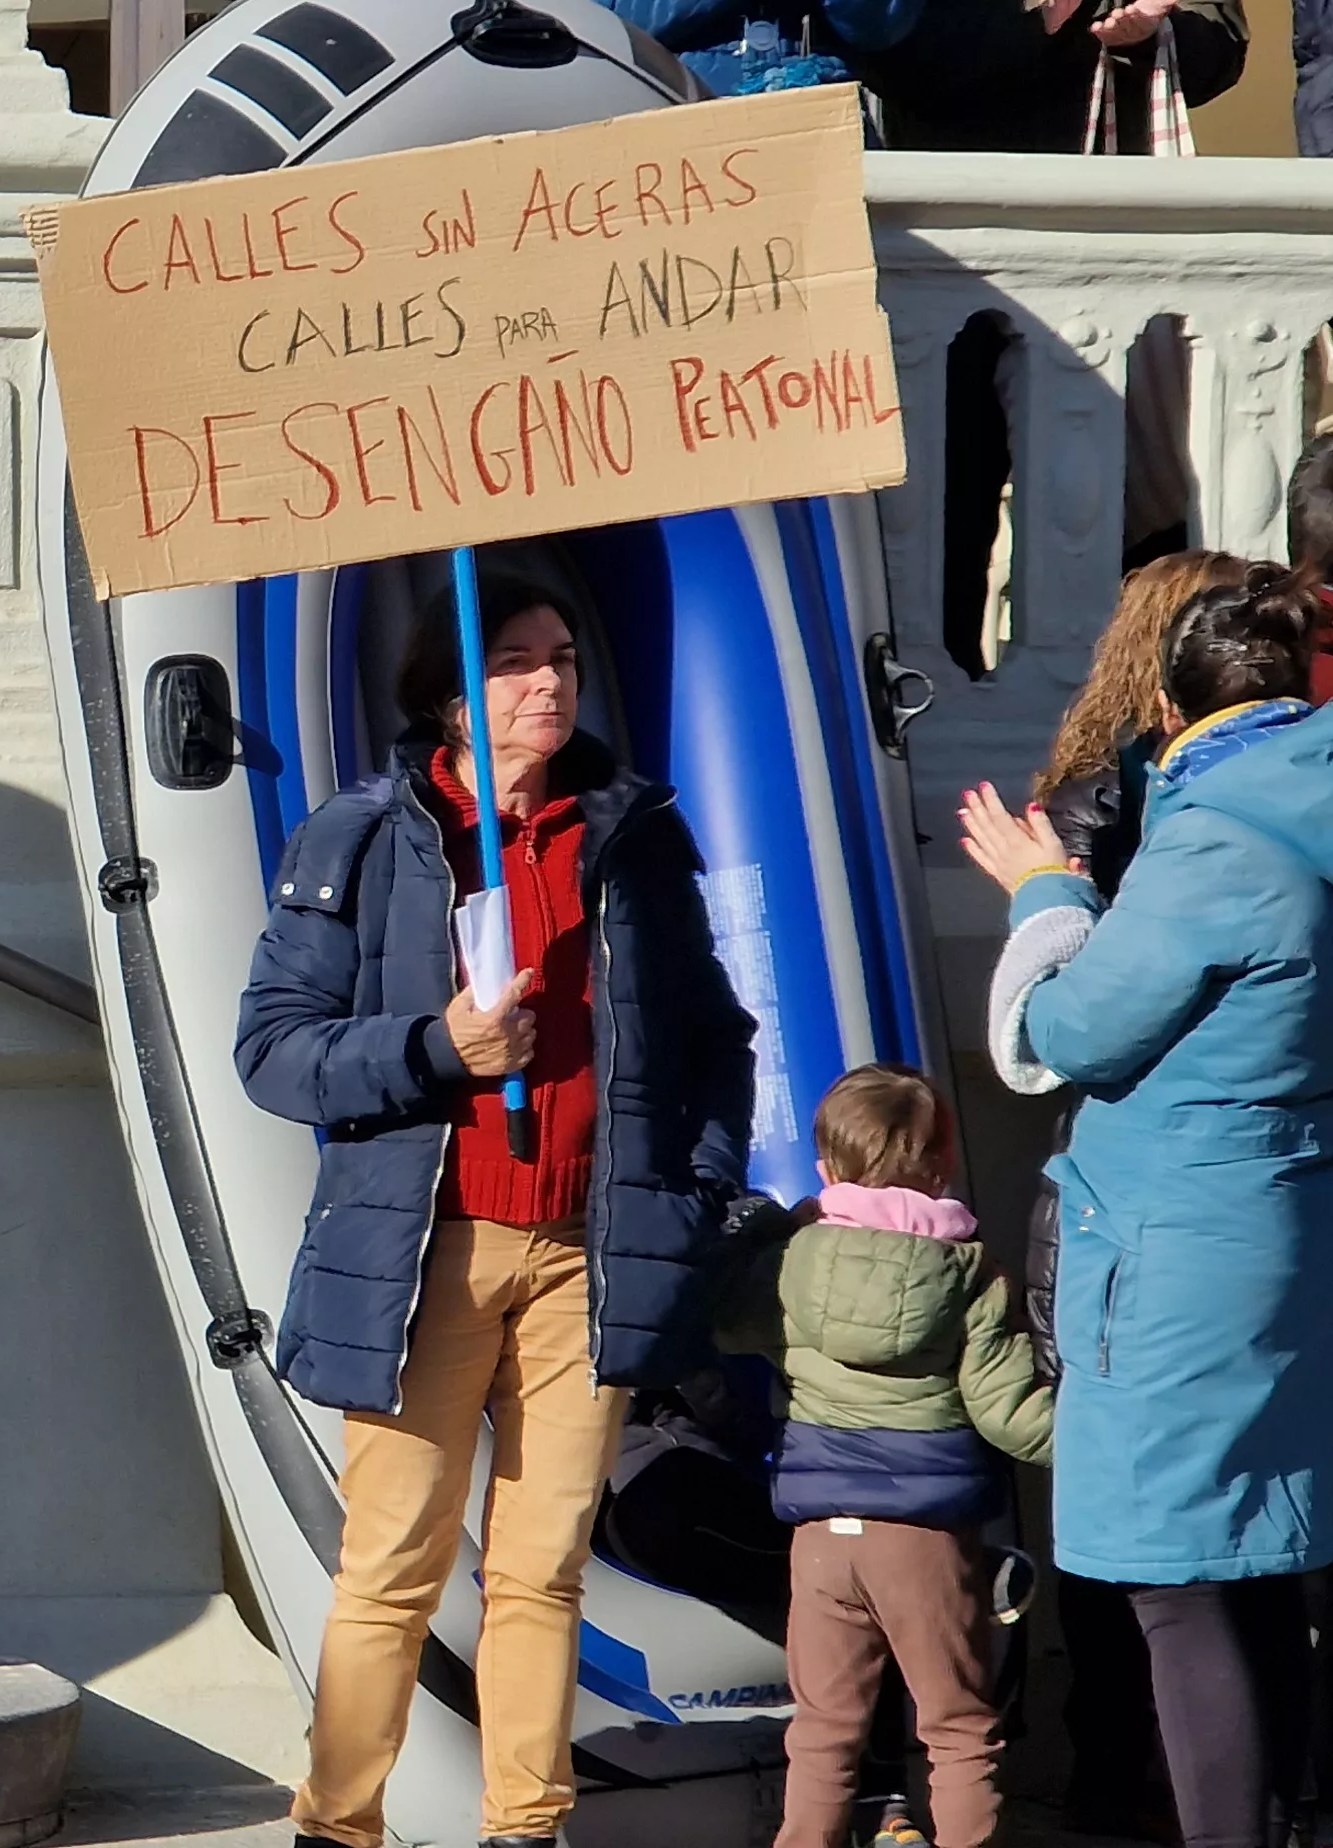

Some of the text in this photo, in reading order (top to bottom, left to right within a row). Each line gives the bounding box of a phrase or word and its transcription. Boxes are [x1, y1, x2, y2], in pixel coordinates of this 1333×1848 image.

[103, 148, 758, 294] CALLES SIN ACERAS
[238, 237, 809, 373] CALLES PARA ANDAR
[127, 348, 901, 540] DESENGAÑO PEATONAL
